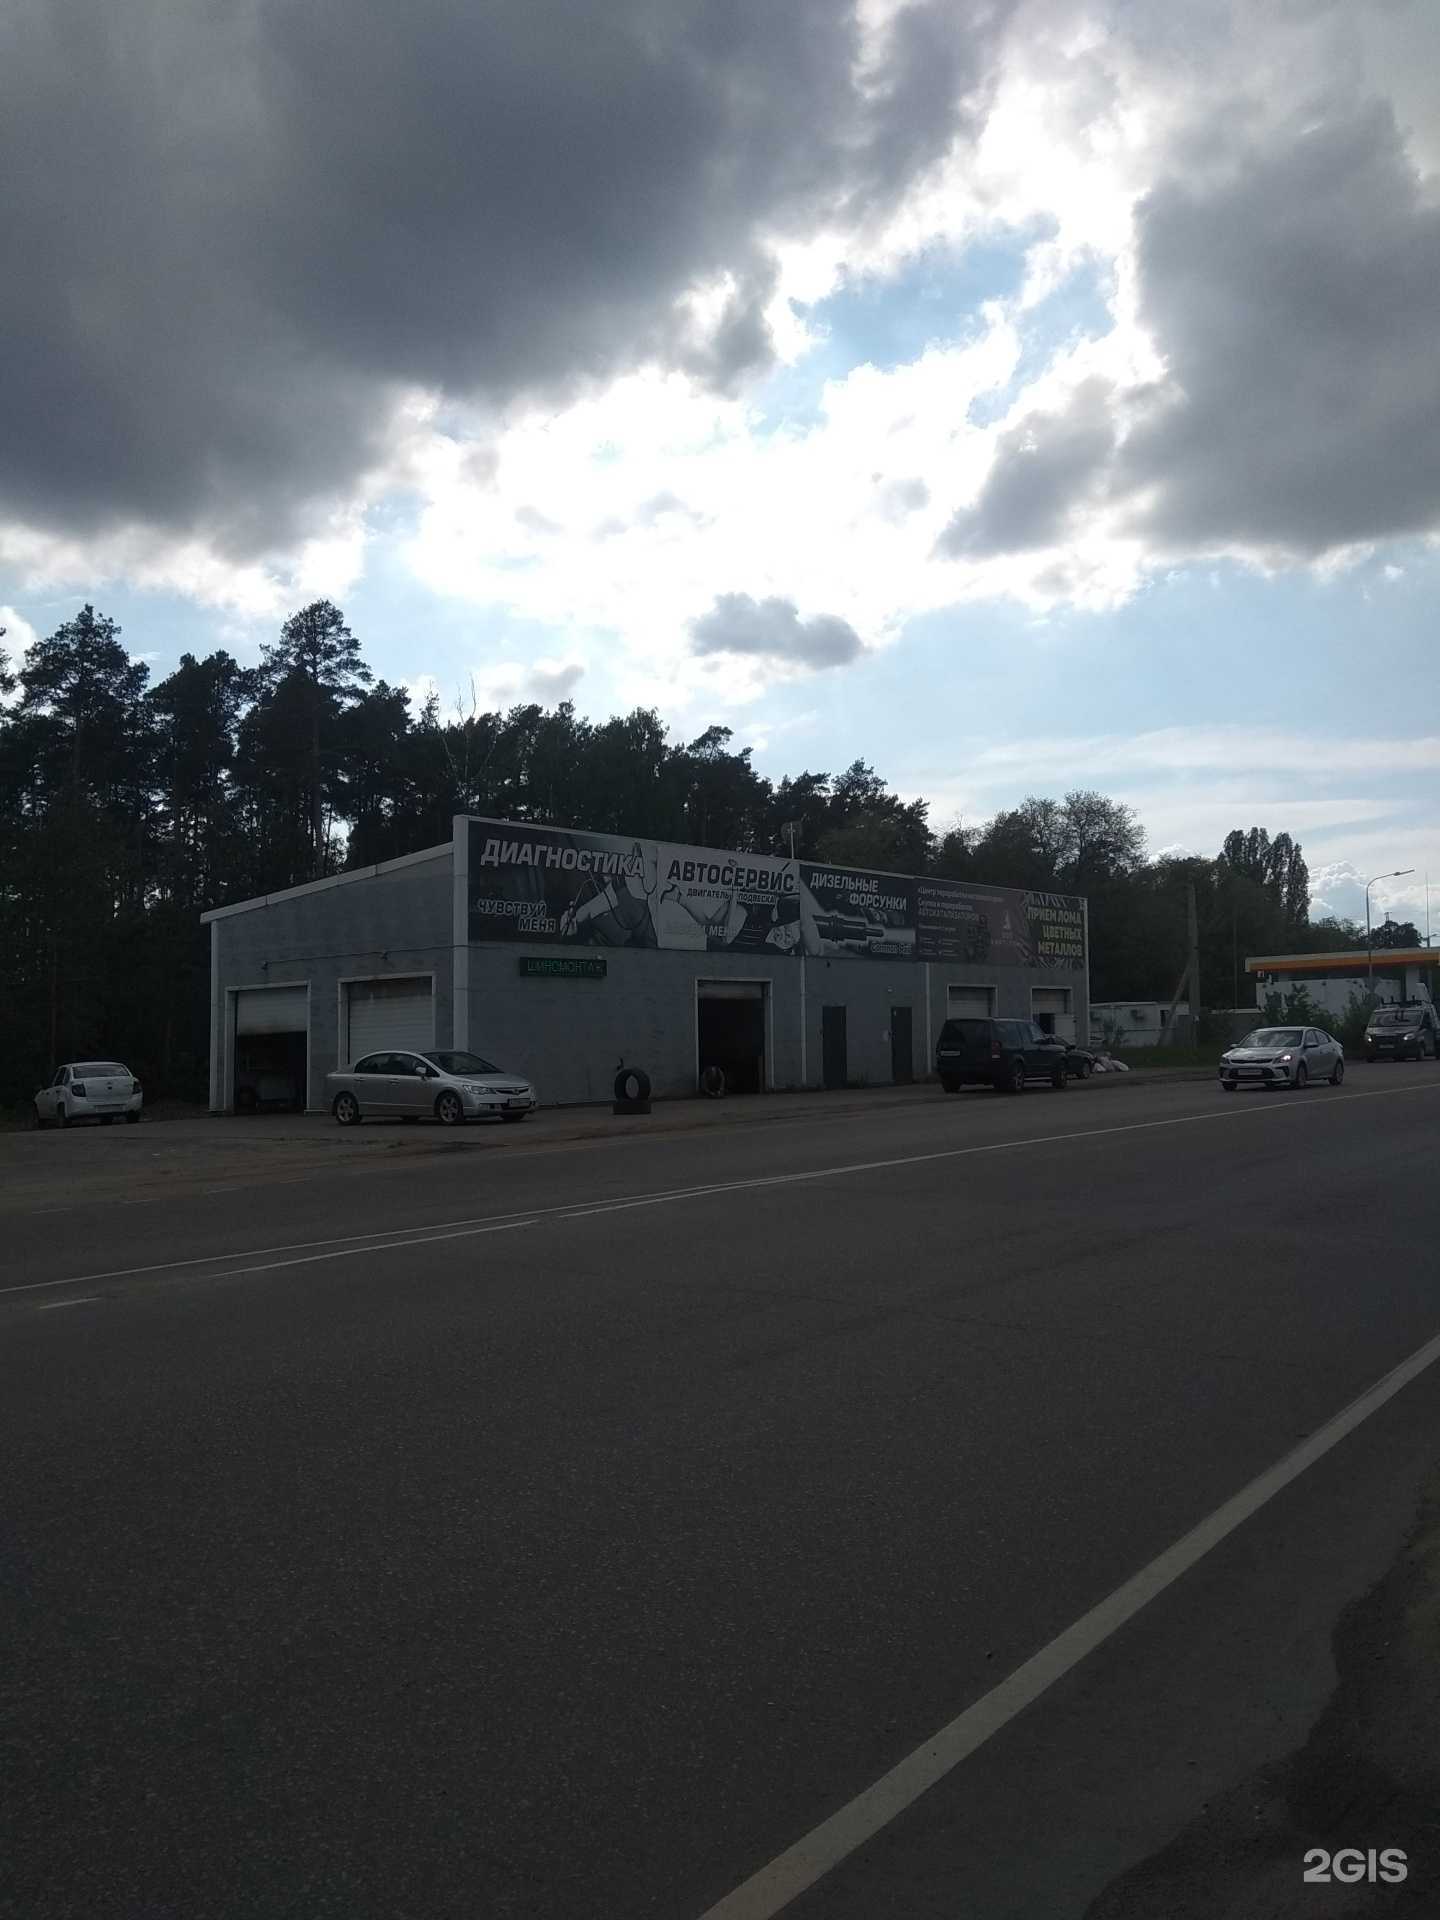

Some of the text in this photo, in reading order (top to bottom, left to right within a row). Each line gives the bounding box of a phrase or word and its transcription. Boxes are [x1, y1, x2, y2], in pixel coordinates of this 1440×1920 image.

[480, 838, 644, 877] ДИАГНОСТИКА
[667, 859, 794, 892] АВТОСЕРВИС
[810, 872, 879, 893] ДИЗЕЛЬНЫЕ
[478, 898, 547, 916] ЧУВСТВУЙ
[849, 892, 907, 912] ФОРСУНКИ
[519, 917, 557, 933] МЕНЯ
